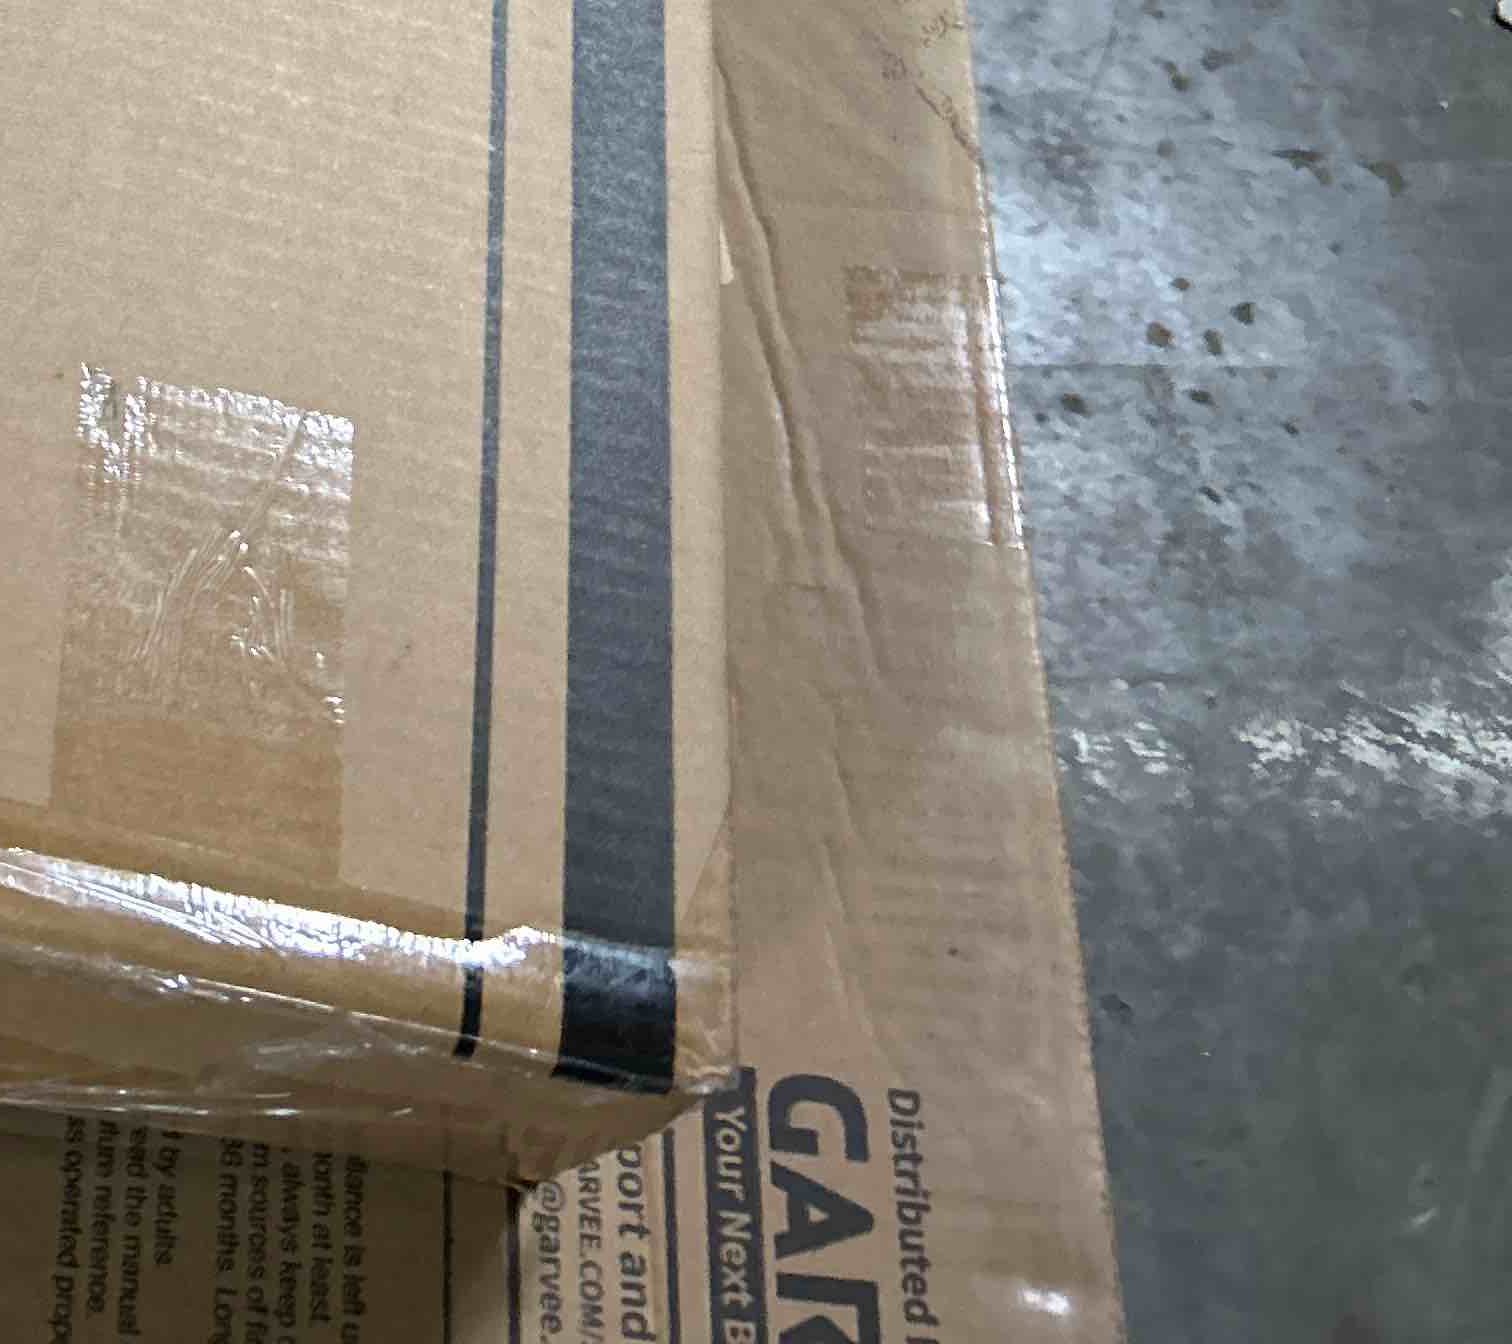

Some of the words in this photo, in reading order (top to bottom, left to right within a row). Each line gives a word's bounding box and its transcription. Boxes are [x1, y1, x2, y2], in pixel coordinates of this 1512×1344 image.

[152, 1144, 182, 1179] by
[709, 1104, 748, 1202] Your
[56, 1149, 85, 1272] operated
[124, 1185, 149, 1227] the
[246, 1174, 270, 1280] sources
[277, 1161, 306, 1255] always
[311, 1223, 333, 1251] at
[888, 1088, 941, 1323] Distributed
[116, 1233, 142, 1336] manual
[273, 1261, 302, 1329] keep
[309, 1258, 334, 1323] least
[341, 1273, 370, 1317] left
[342, 1245, 364, 1268] is
[617, 1250, 657, 1342] and
[711, 1209, 754, 1311] Next
[245, 1285, 269, 1315] of
